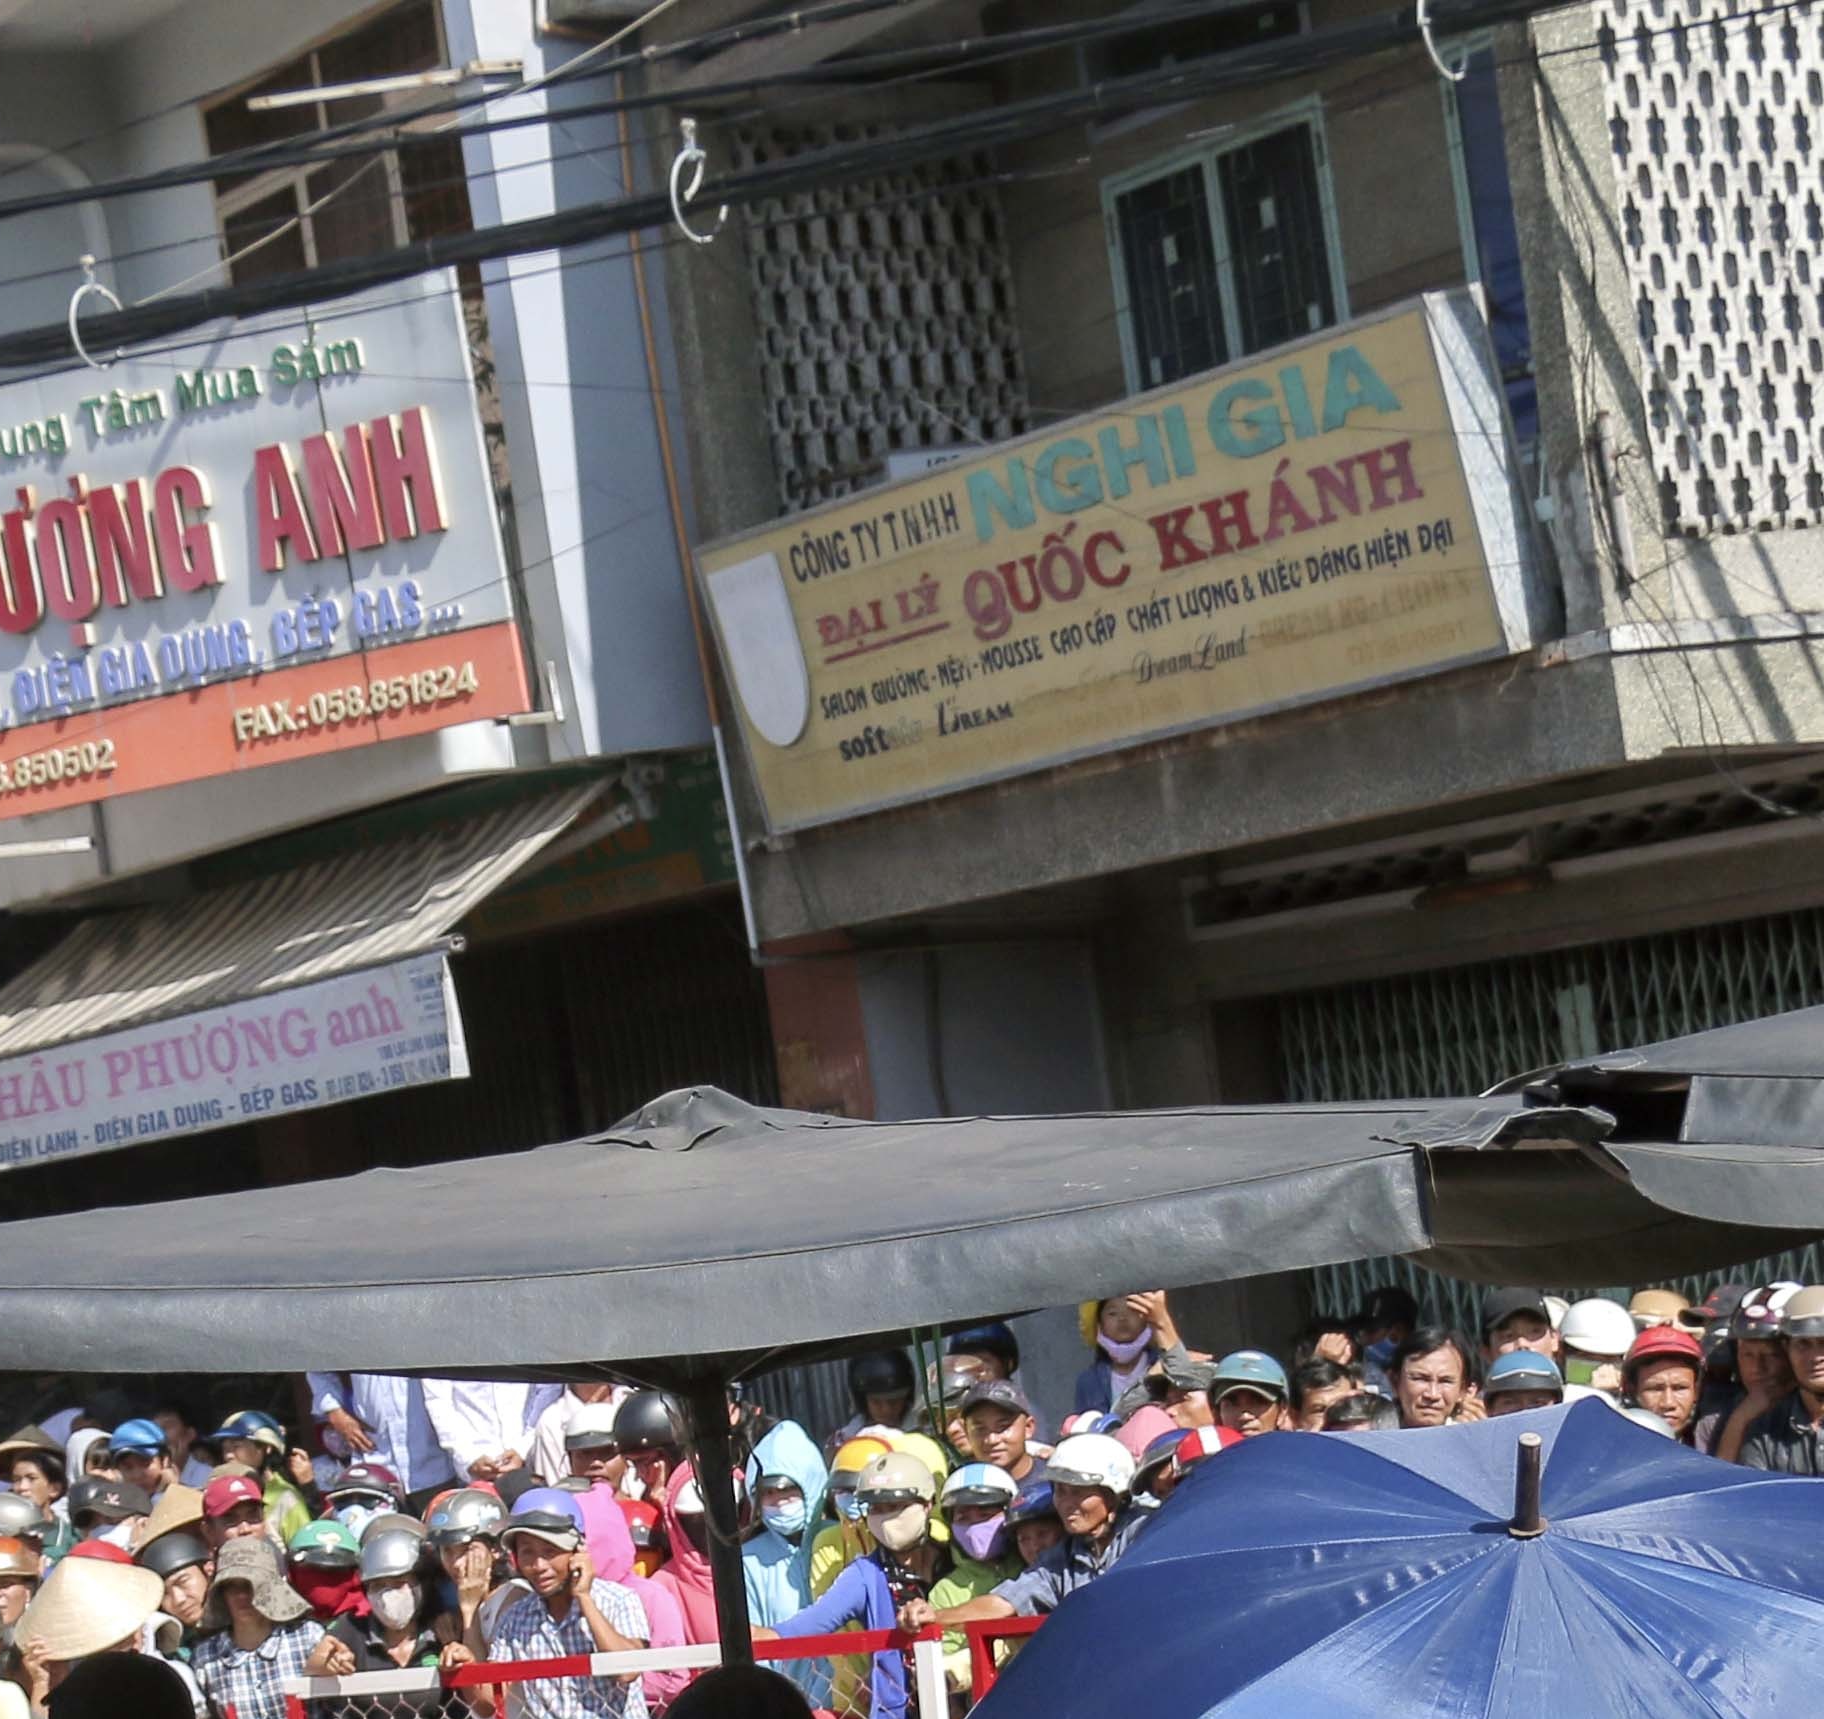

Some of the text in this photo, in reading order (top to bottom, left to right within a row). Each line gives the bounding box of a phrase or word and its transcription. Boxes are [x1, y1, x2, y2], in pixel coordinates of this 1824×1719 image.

[78, 388, 167, 436] Tâm
[174, 365, 263, 412] Mua
[965, 345, 1403, 545] NGHI GIA
[254, 404, 451, 573] ANH
[789, 531, 852, 583] CÔNG
[850, 517, 881, 563] TY
[816, 600, 888, 647] ĐẠI
[963, 521, 1132, 642] QUỐC
[1146, 439, 1426, 573] KHÁNH
[13, 651, 98, 716] ĐIỆN
[99, 640, 161, 698] GIA
[274, 585, 343, 661] BẾP
[351, 579, 425, 641] GAS
[820, 686, 869, 721] SALON
[980, 635, 1044, 675] MOUSSE
[1050, 625, 1083, 656] CAO
[1084, 609, 1117, 646] CẤP
[1364, 526, 1412, 569] HIỆN
[1418, 518, 1455, 553] ĐẠI
[101, 1006, 319, 1099] PHƯỢNG
[327, 982, 406, 1048] anh
[136, 1109, 169, 1136] GIA
[239, 1077, 275, 1115] BẾP
[279, 1077, 320, 1107] GAS
